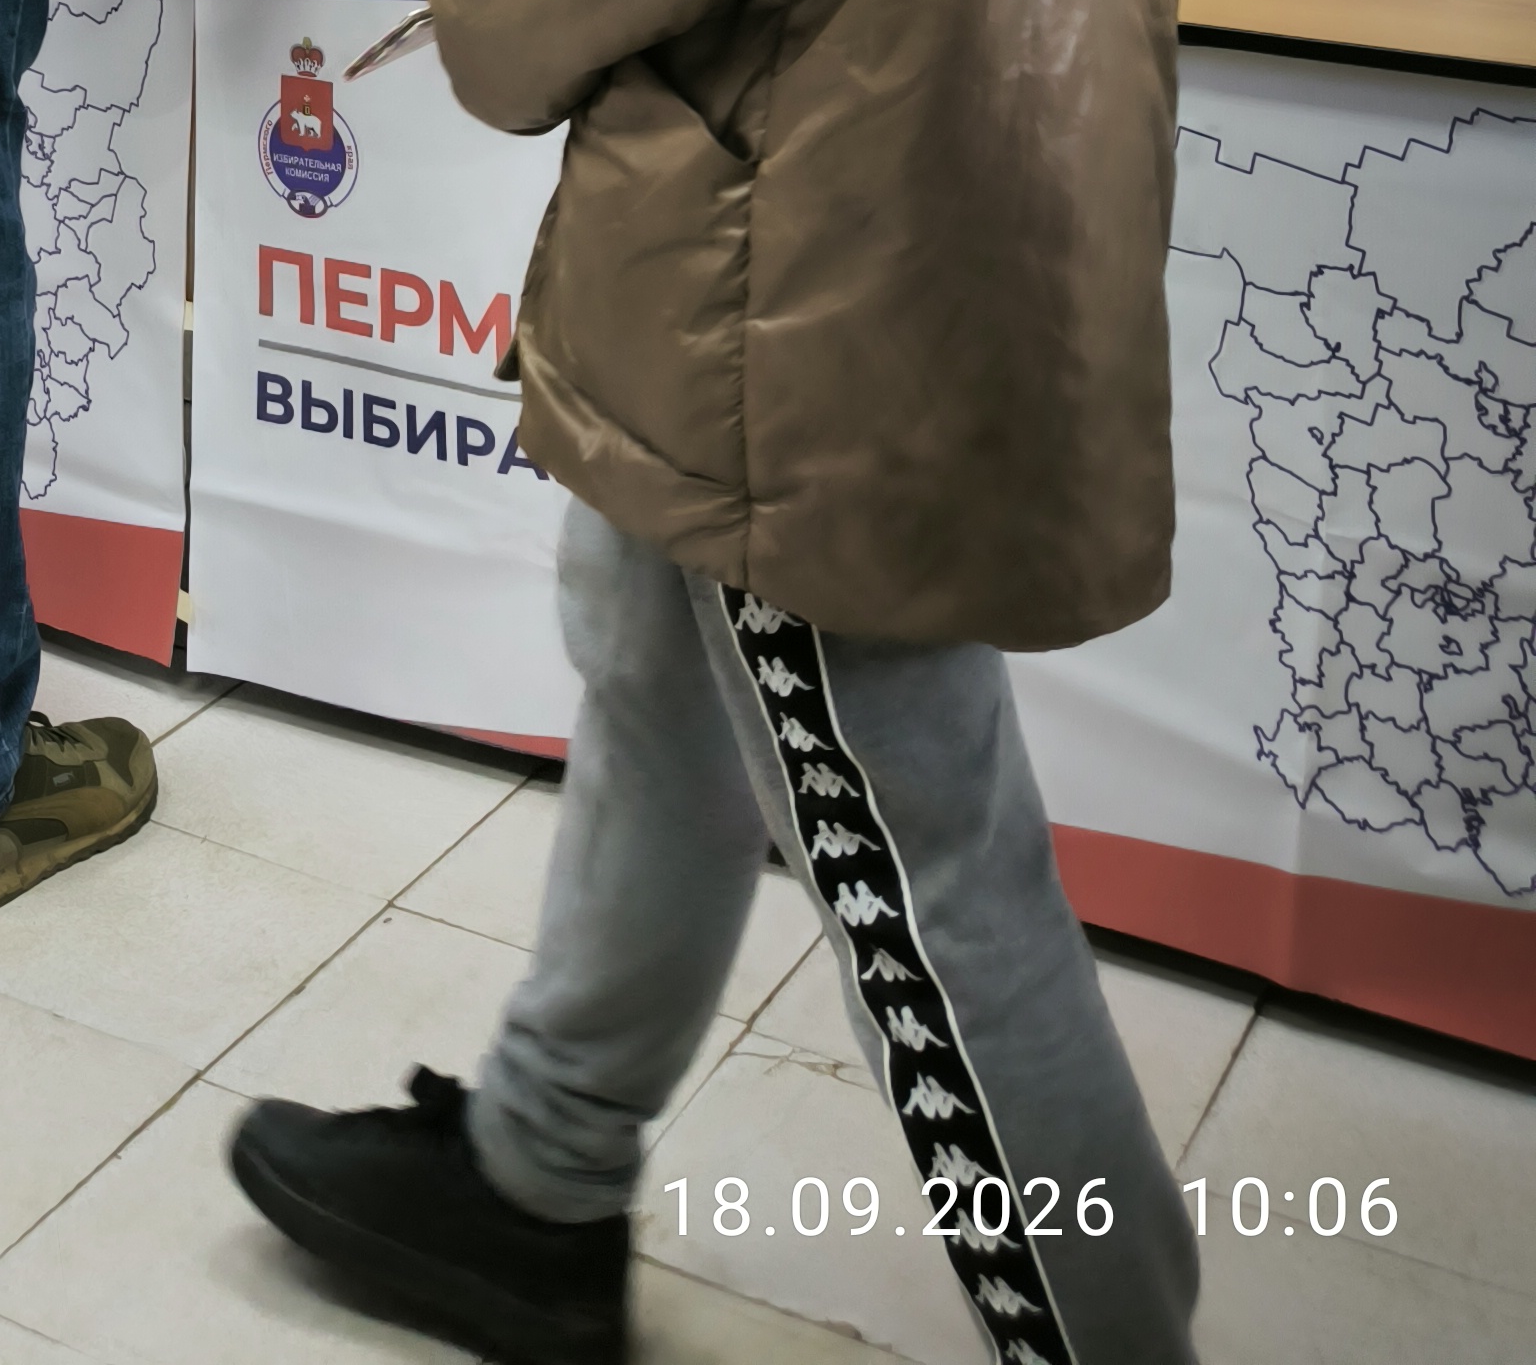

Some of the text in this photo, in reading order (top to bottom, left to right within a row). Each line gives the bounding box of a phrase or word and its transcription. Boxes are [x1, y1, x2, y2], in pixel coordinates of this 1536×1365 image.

[273, 153, 342, 173] ИЗБИРАТЕЛЬНАЯ
[285, 167, 330, 183] КОМИССИЯ
[259, 244, 512, 363] ПЕРМ
